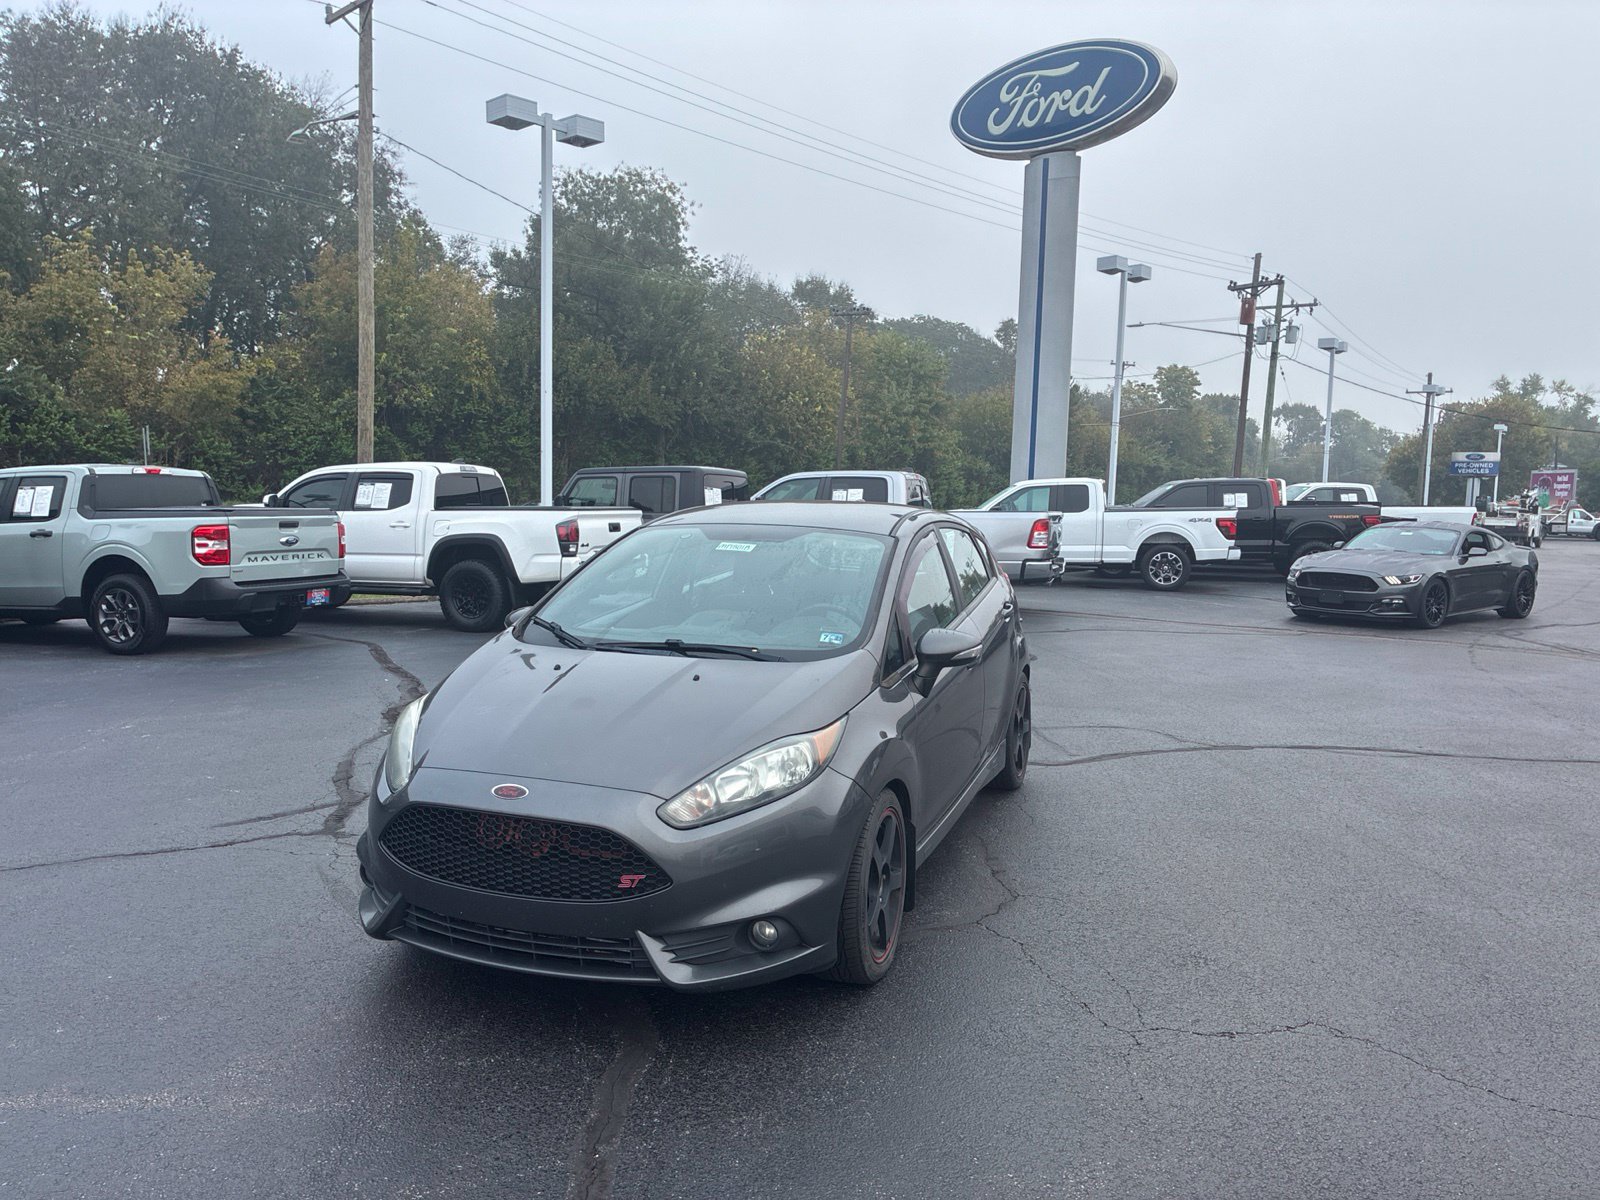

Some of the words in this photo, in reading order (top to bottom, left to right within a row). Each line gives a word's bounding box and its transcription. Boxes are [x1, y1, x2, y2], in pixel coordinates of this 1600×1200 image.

[987, 61, 1112, 136] Ford
[247, 552, 325, 563] MAVERICK
[617, 874, 647, 888] ST
